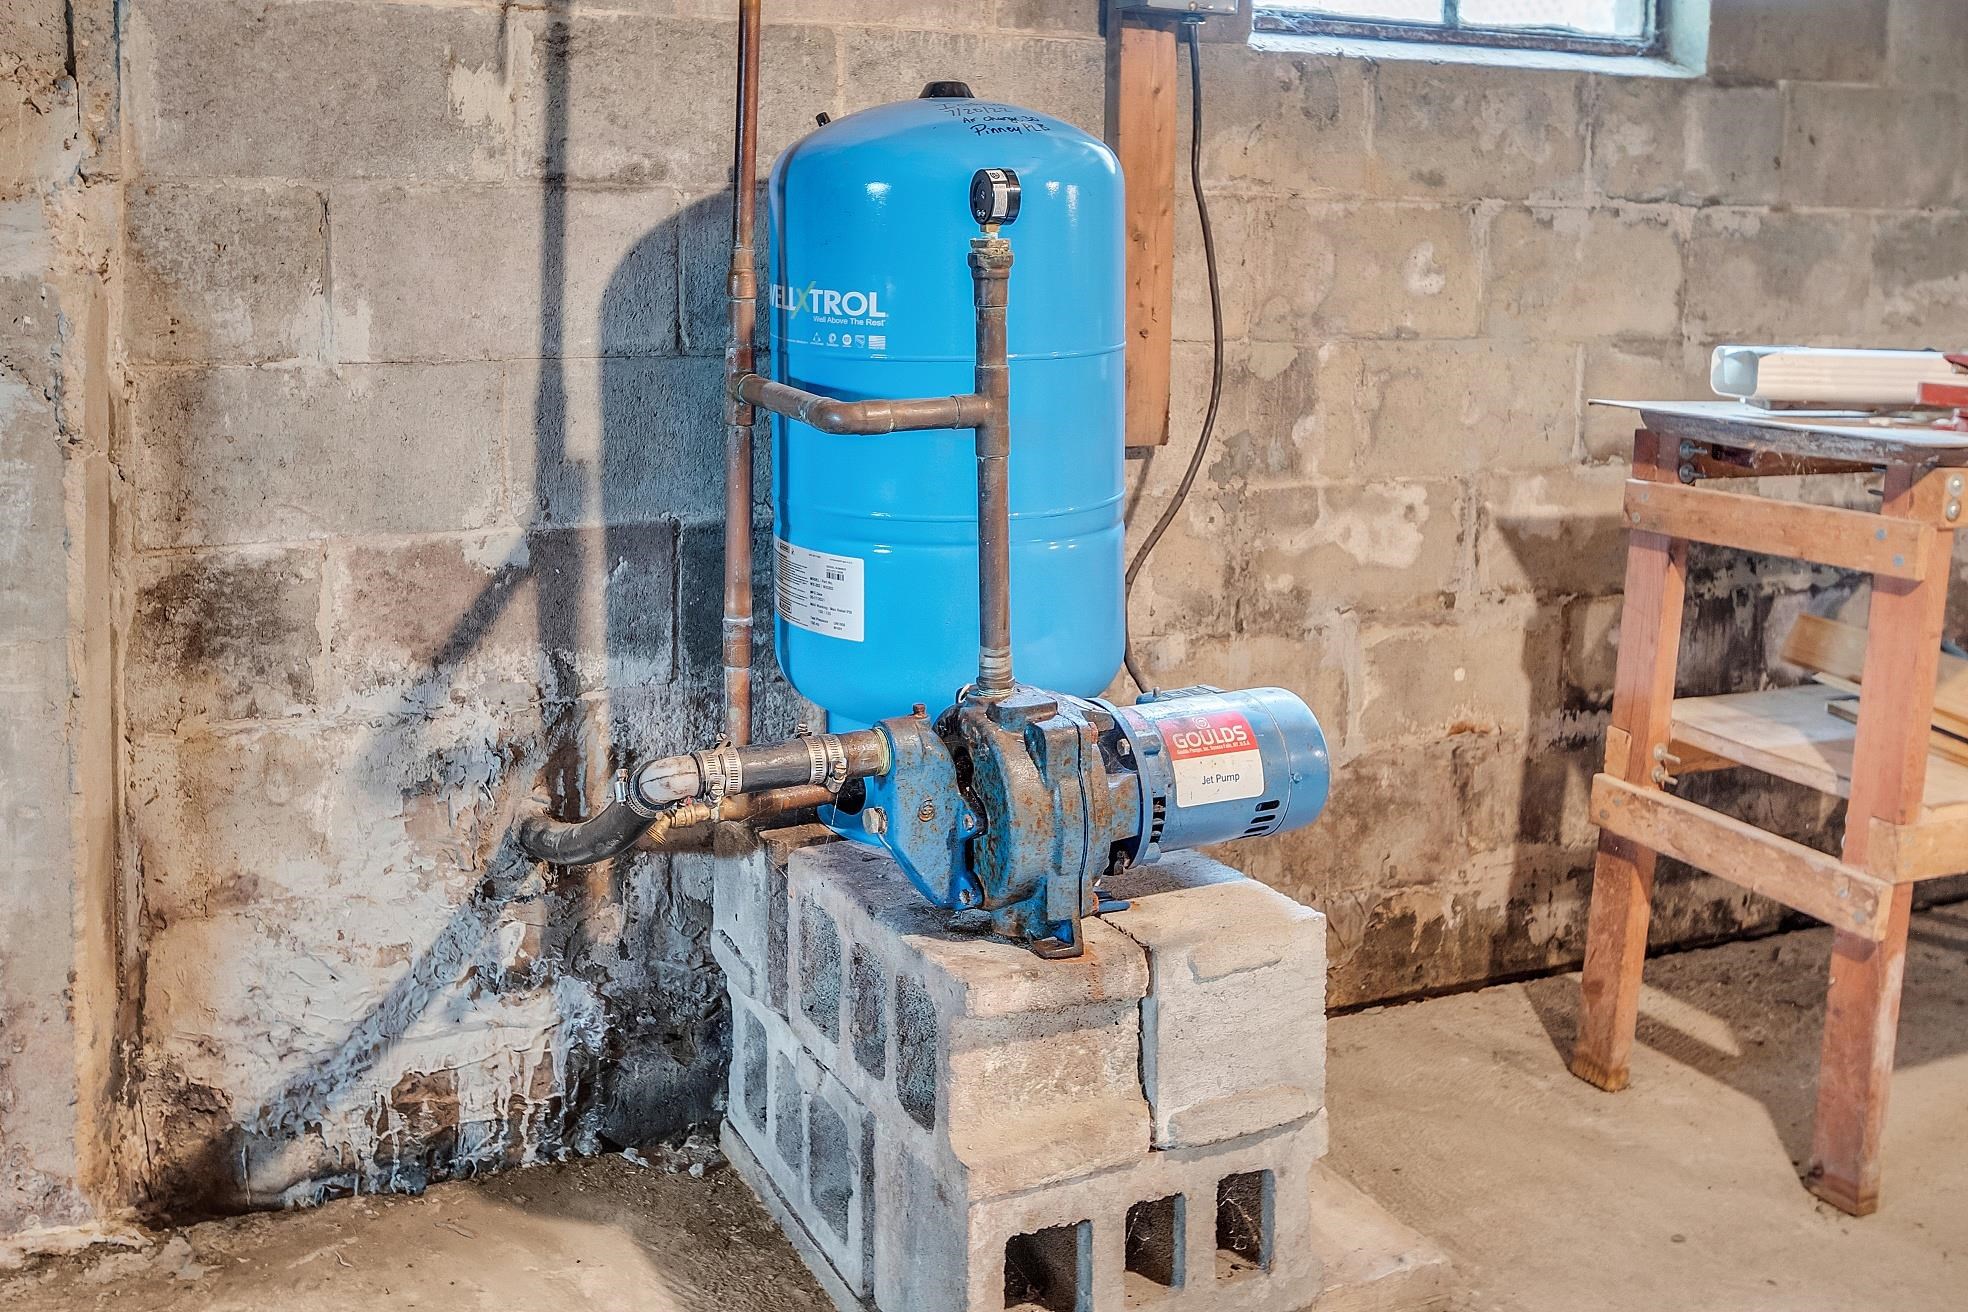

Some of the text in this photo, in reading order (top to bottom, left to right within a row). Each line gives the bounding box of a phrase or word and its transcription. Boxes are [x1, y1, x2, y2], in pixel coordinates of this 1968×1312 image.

[849, 317, 864, 326] The
[865, 318, 885, 327] Rest
[1172, 725, 1248, 749] GOULDS
[1202, 773, 1240, 785] Jet Pump
